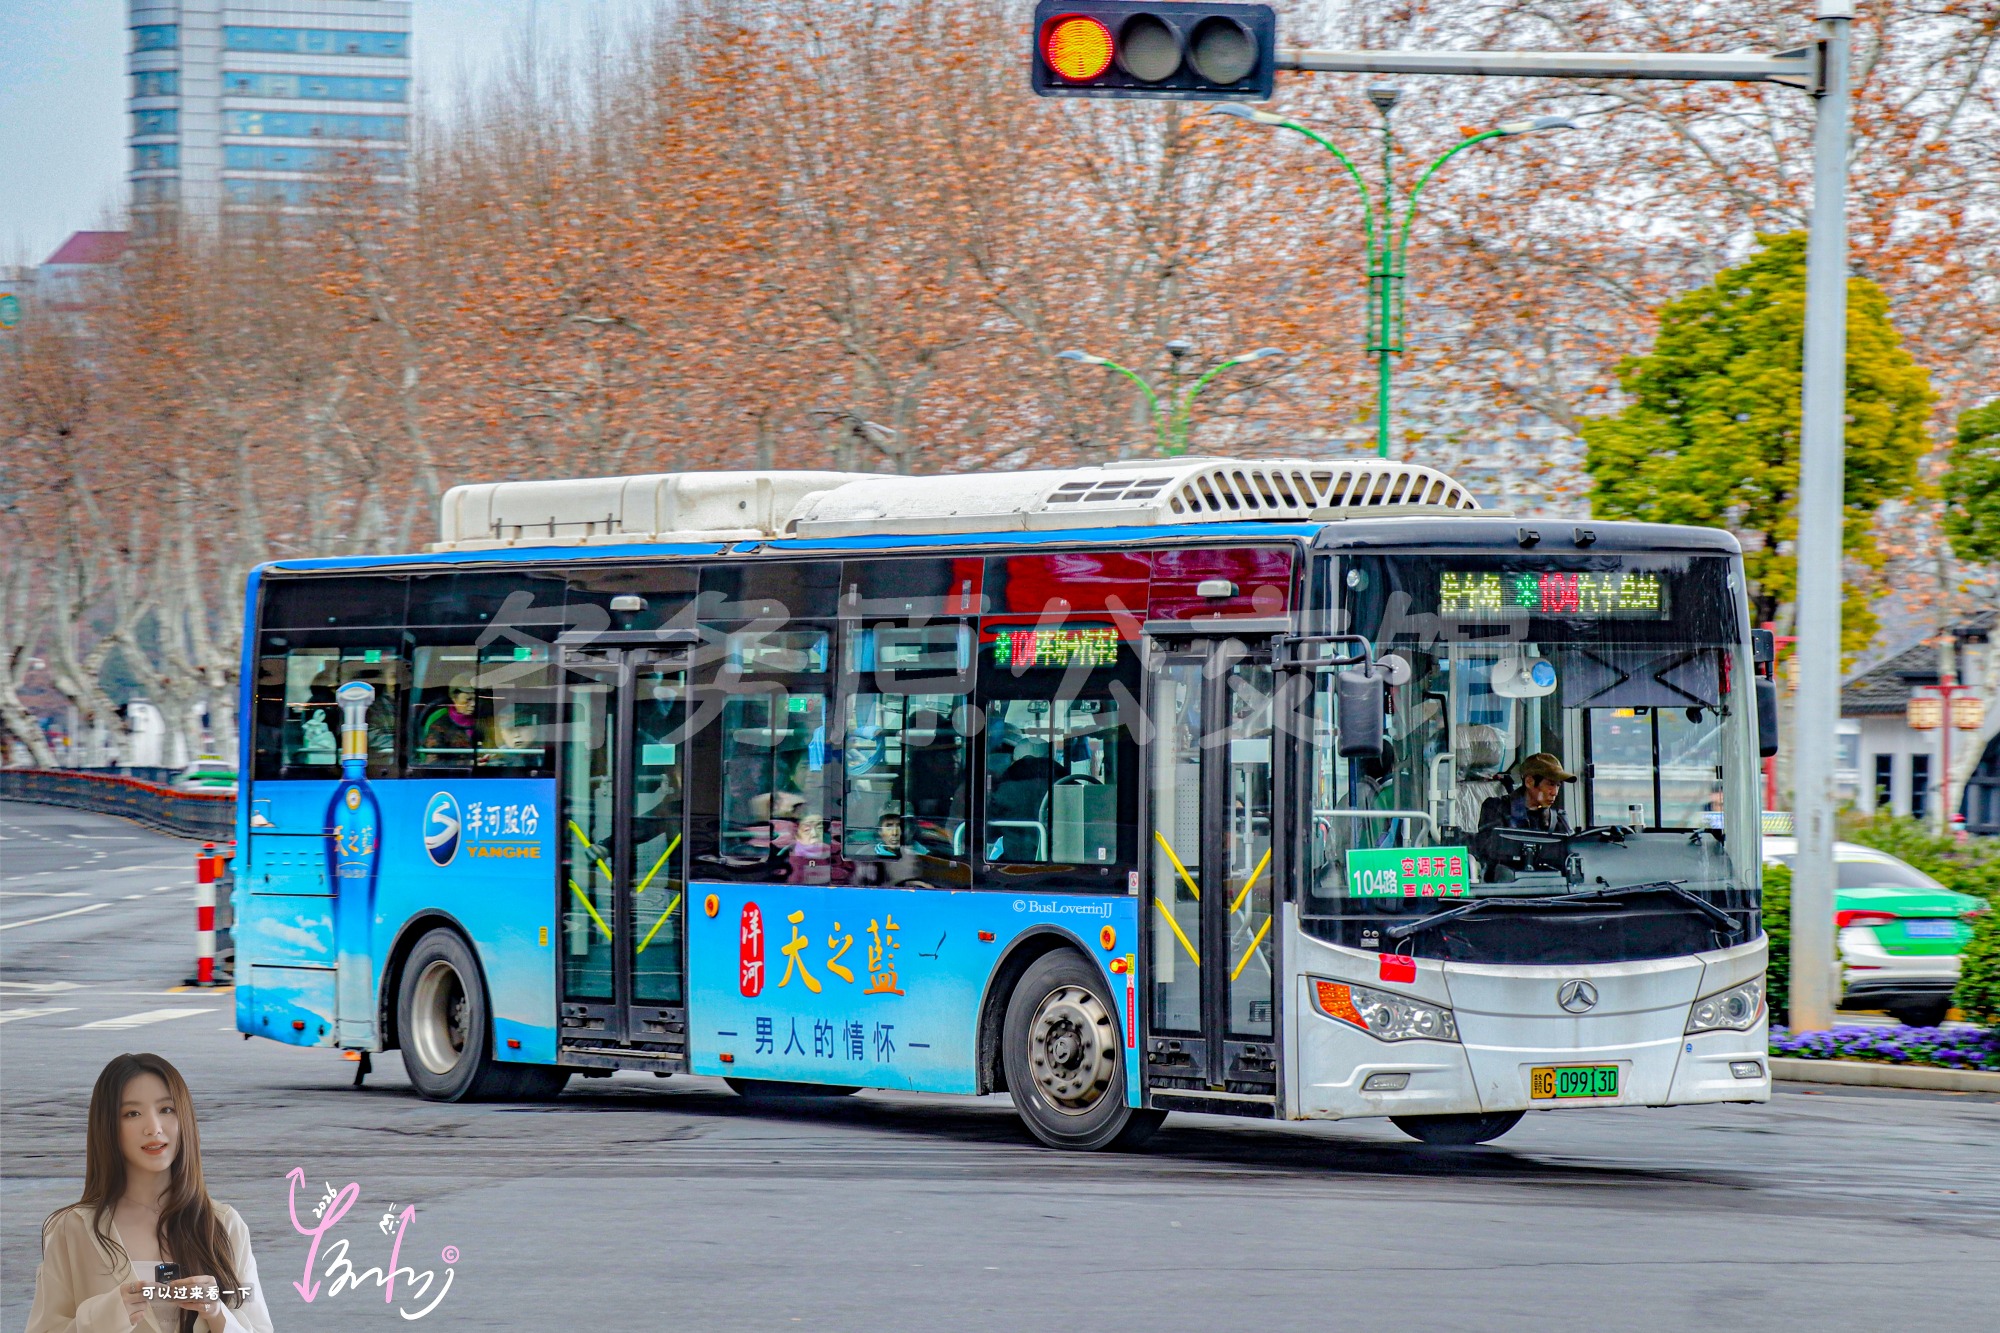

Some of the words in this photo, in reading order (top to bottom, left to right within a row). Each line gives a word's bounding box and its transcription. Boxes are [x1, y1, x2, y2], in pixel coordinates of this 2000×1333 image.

[1539, 573, 1578, 613] 104
[466, 801, 540, 838] 洋河股份
[466, 846, 541, 858] YANGHE
[1401, 856, 1462, 877] 空调开启
[1353, 868, 1398, 895] 104路
[741, 908, 764, 993] 洋河
[755, 1016, 896, 1063] 男人的情怀
